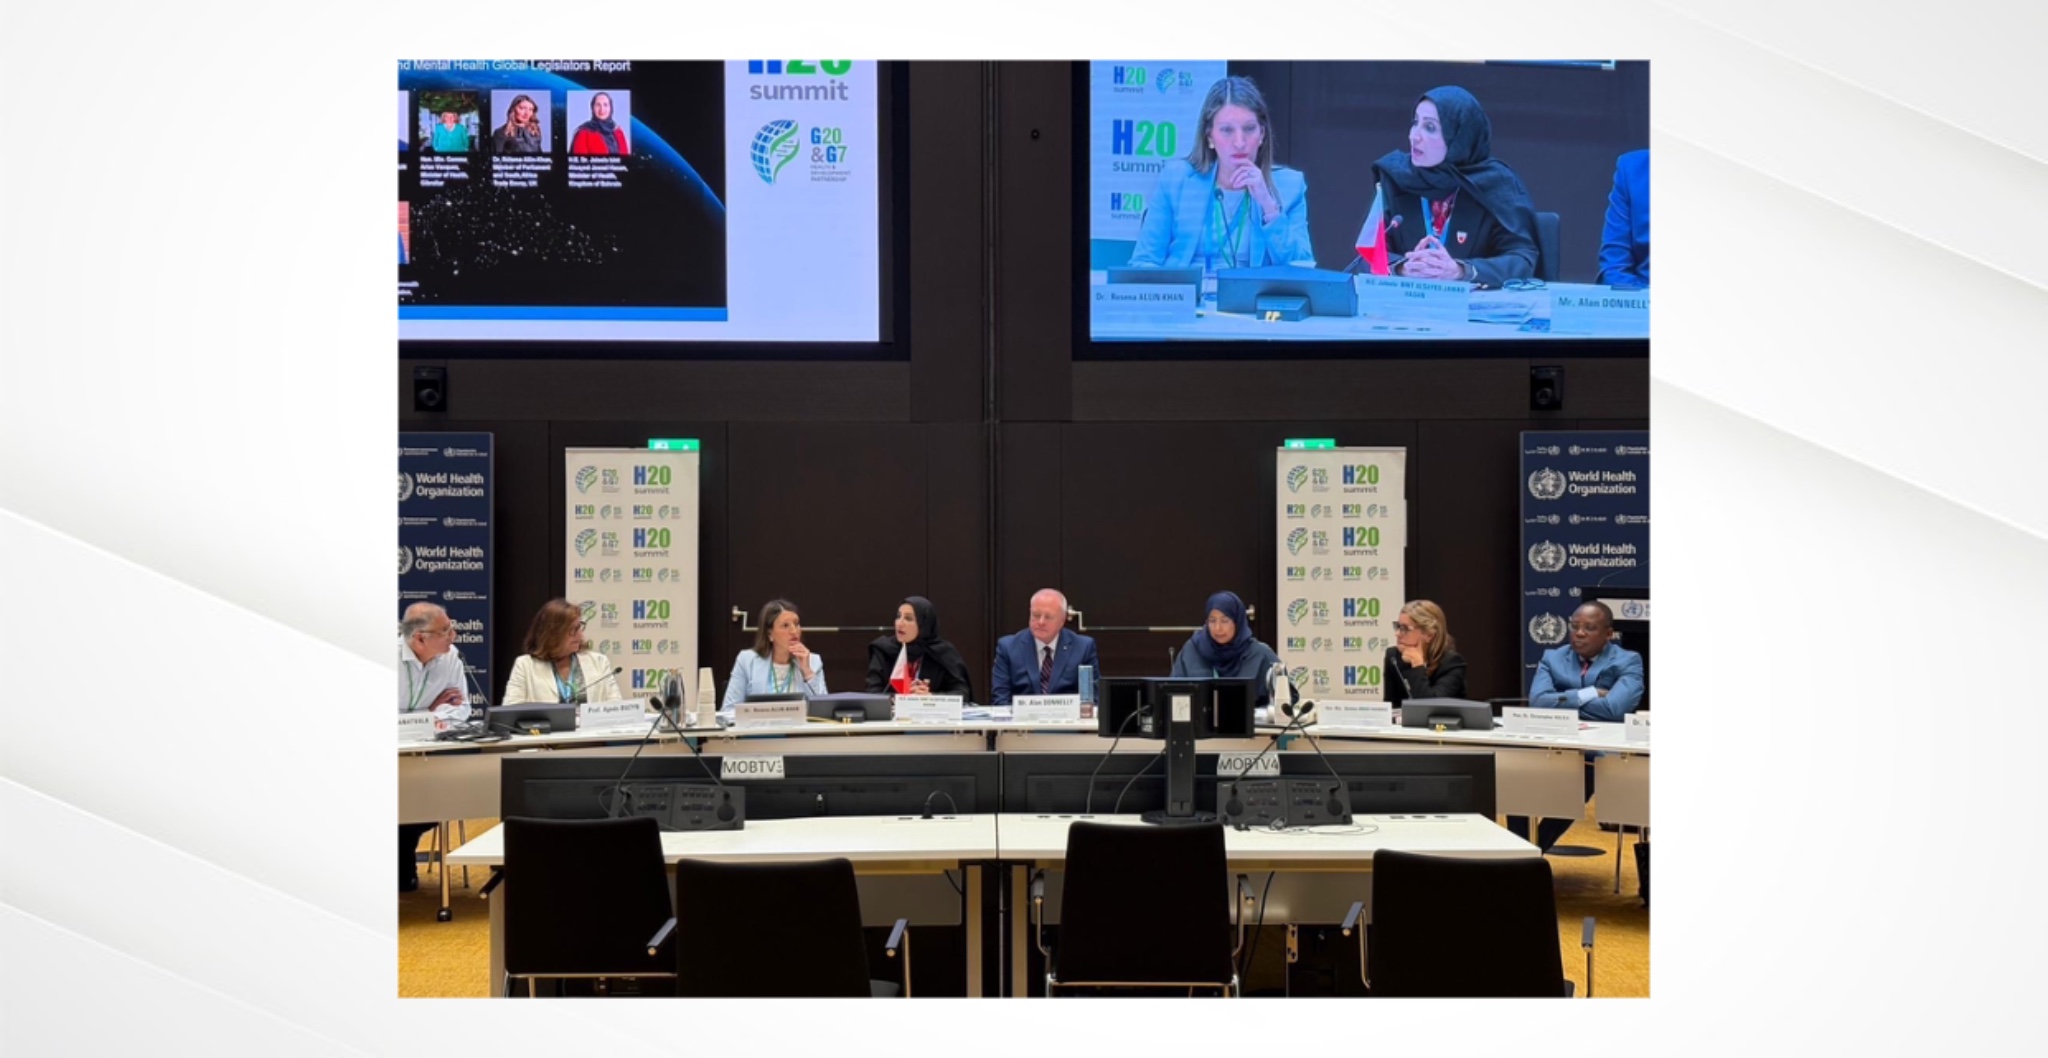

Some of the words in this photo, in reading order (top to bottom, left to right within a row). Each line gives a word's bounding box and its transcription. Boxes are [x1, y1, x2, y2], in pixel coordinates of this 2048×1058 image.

[414, 60, 450, 70] Mental
[454, 60, 489, 70] Health
[492, 60, 529, 70] Global
[531, 60, 591, 73] Legislators
[593, 60, 631, 73] Report
[749, 79, 848, 100] summit
[810, 127, 842, 144] G20
[1112, 119, 1177, 157] H20
[1112, 160, 1166, 173] summi
[1558, 296, 1576, 307] Mr.
[1578, 298, 1600, 307] Alan
[415, 472, 447, 484] World
[450, 472, 484, 484] Health
[634, 465, 671, 485] H20
[1343, 465, 1379, 485] H20
[1568, 470, 1599, 481] World
[1602, 470, 1636, 481] Health
[415, 485, 484, 499] Organization
[1568, 483, 1636, 496] Organization
[633, 527, 671, 548] H20
[1343, 527, 1379, 547] H20
[415, 546, 447, 558] World
[449, 546, 484, 558] Health
[1568, 543, 1599, 555] World
[1602, 543, 1636, 555] Health
[415, 558, 484, 572] Organization
[1568, 556, 1636, 569] Organization
[633, 600, 670, 620] H20
[1343, 598, 1380, 617] H20
[1344, 619, 1378, 627] summit
[1344, 665, 1380, 685] H20
